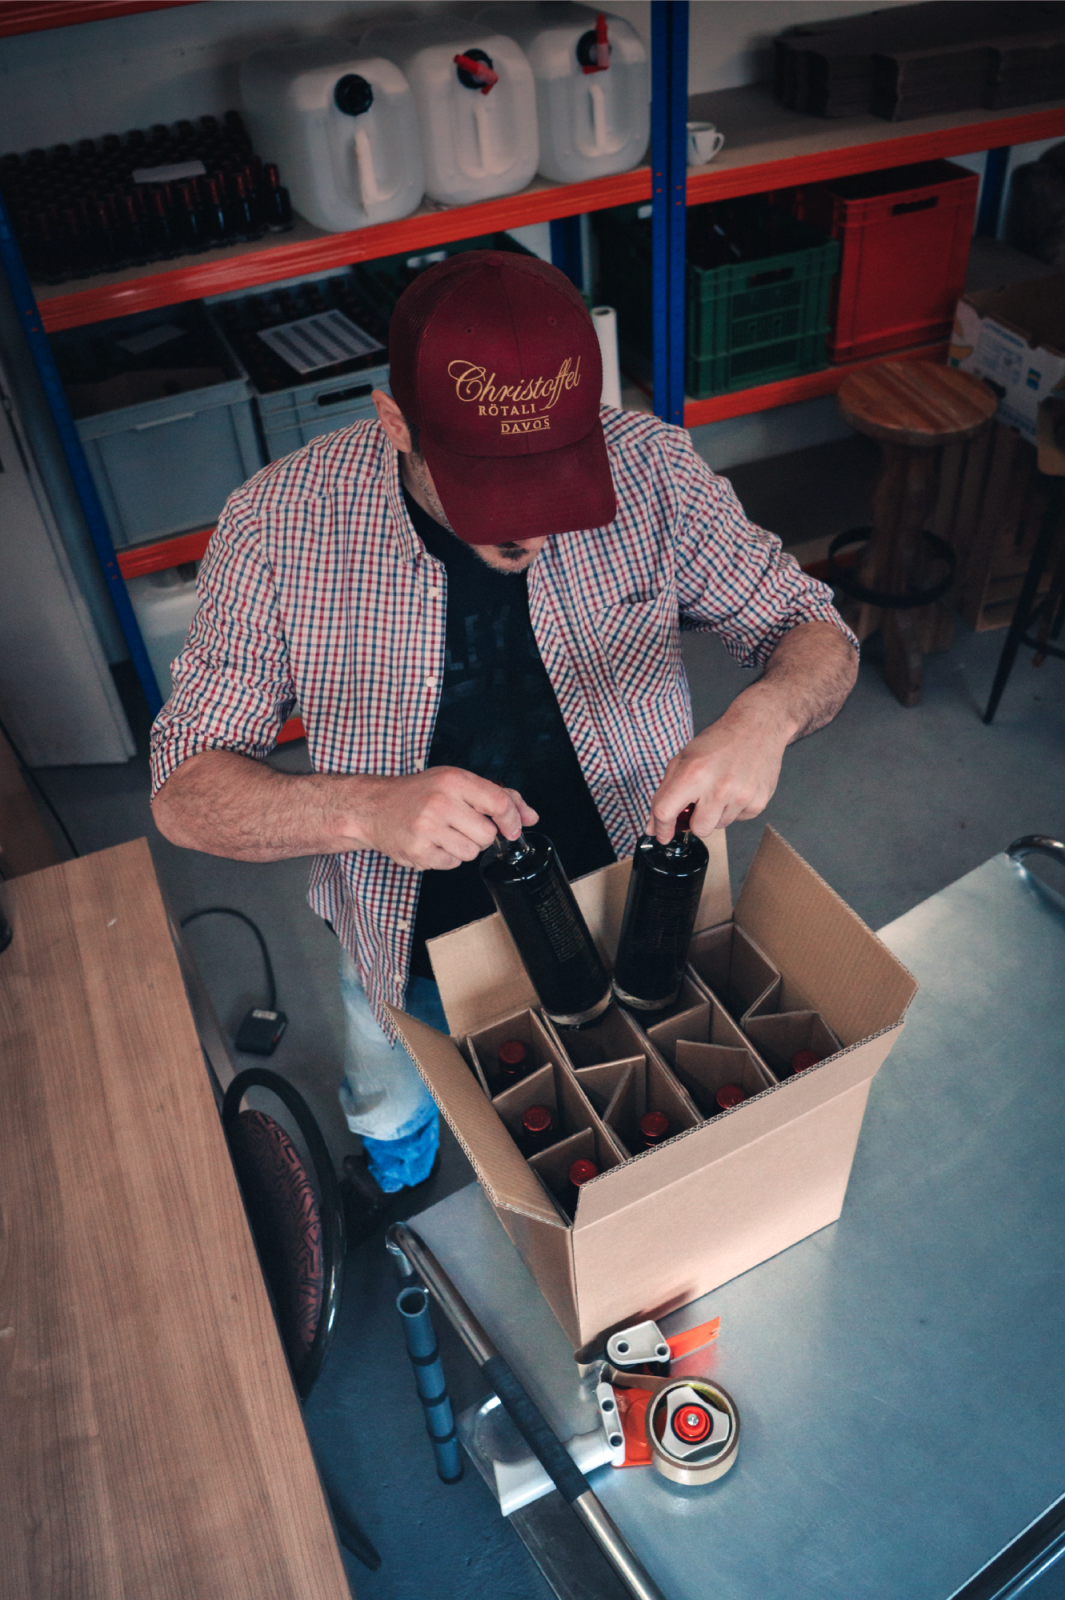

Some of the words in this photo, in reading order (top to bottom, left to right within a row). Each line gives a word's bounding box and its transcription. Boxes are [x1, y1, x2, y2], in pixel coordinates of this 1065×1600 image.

[447, 355, 581, 411] Christoffel
[478, 403, 537, 416] RÖTALI
[500, 418, 551, 433] DAVOS
